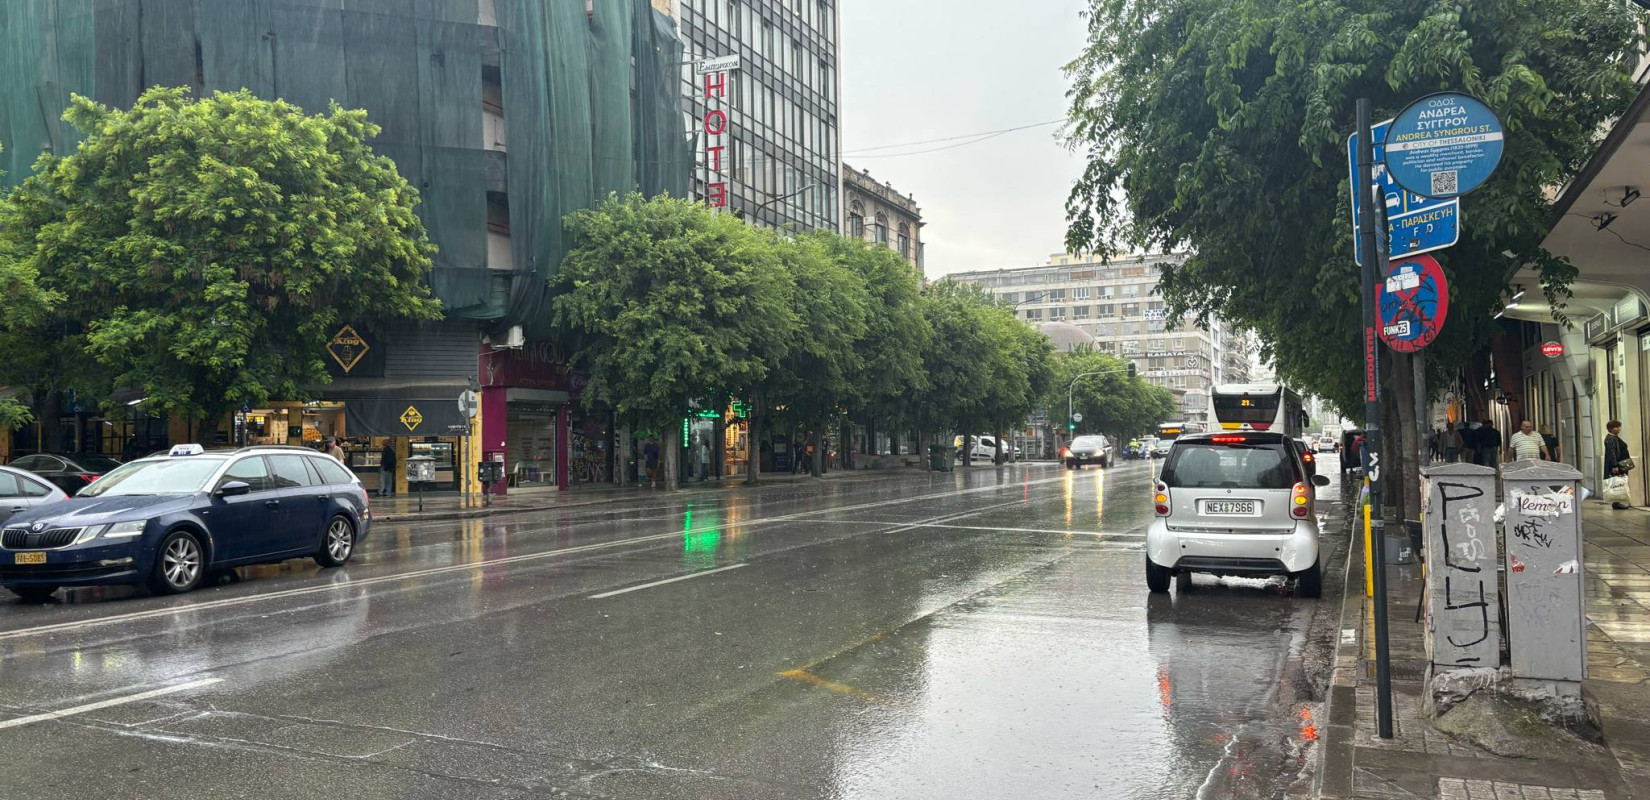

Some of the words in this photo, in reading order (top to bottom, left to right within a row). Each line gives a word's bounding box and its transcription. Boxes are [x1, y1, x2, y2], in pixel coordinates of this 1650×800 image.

[1428, 98, 1456, 108] ΟΔΟΣ
[1418, 106, 1466, 119] ΑΝΔΡΕΑ
[1417, 116, 1468, 130] ΣΥΓΓΡΟΥ
[1396, 131, 1431, 142] ANDREA
[1434, 126, 1477, 137] SYNGROU
[1479, 125, 1492, 133] ST.
[1401, 207, 1453, 229] ΠΑΡΑΣΚΕΥΗ
[1383, 324, 1407, 336] FUNK25
